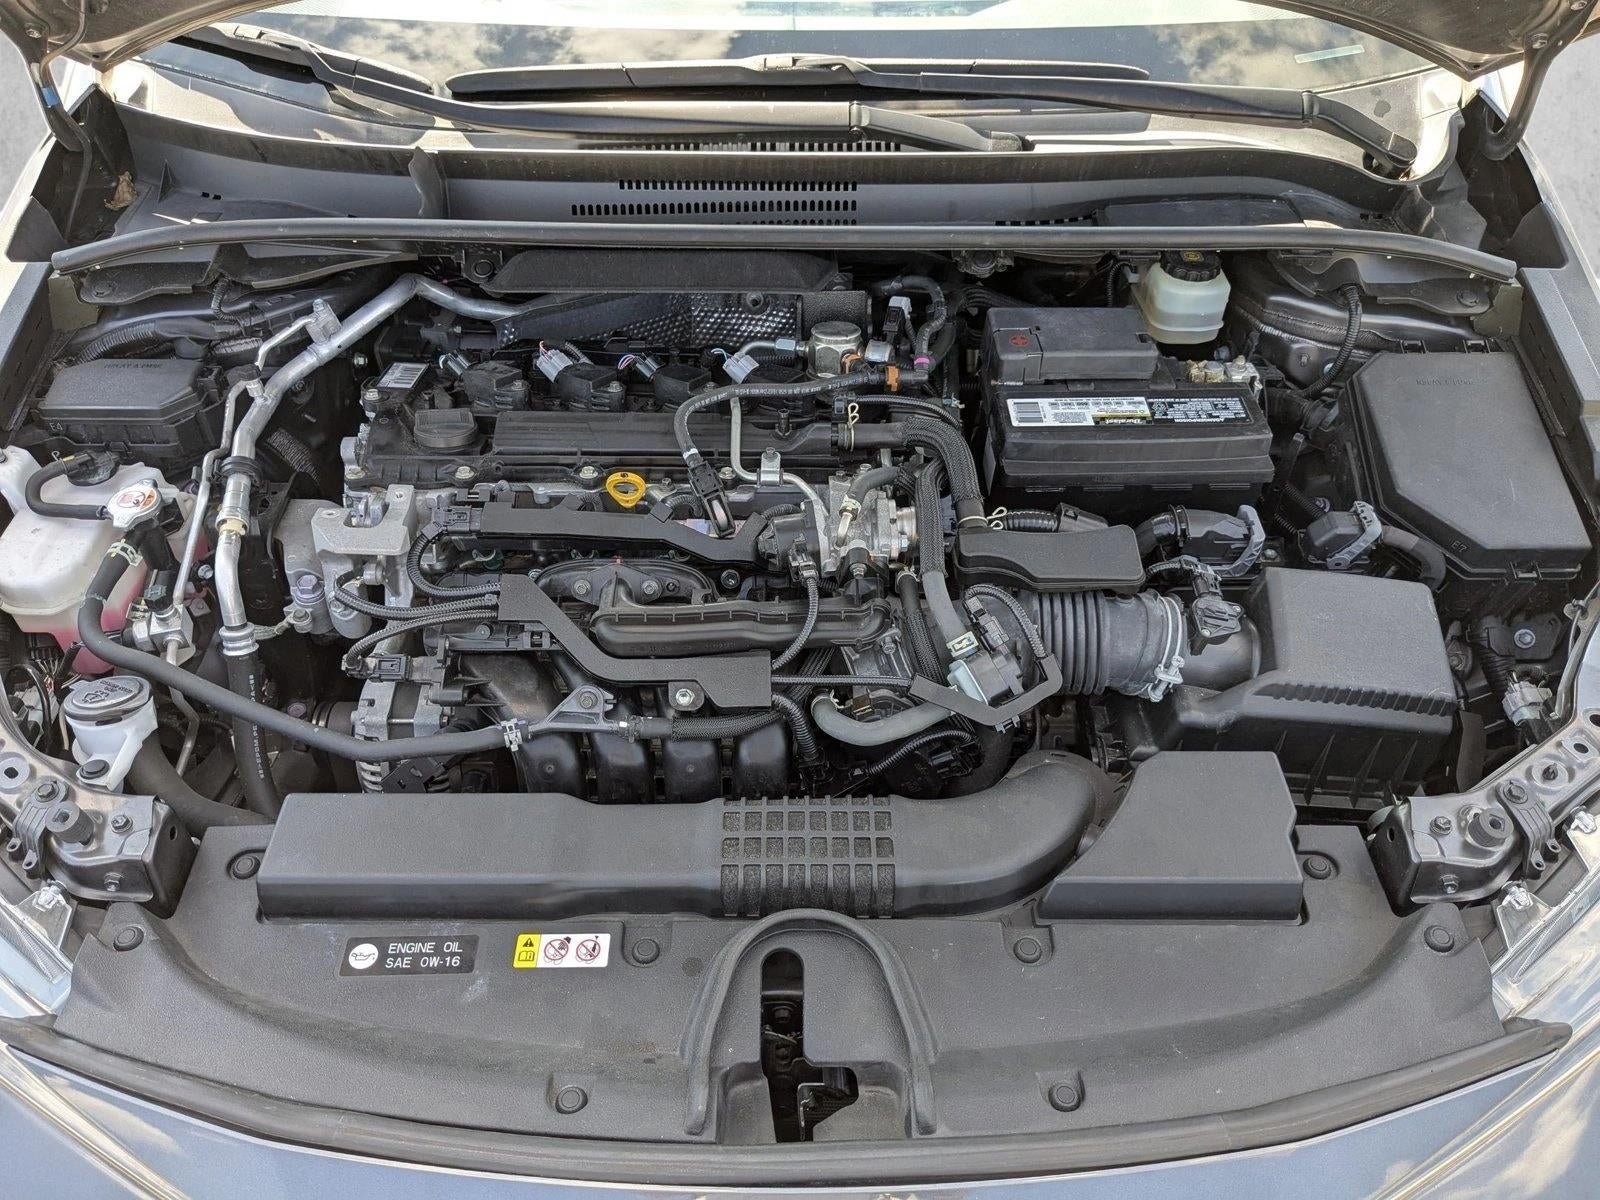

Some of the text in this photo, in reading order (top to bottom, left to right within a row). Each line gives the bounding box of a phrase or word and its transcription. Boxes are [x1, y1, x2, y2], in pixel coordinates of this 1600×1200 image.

[388, 941, 463, 954] ENGINE OIL
[385, 956, 461, 968] SAE 0W-16
